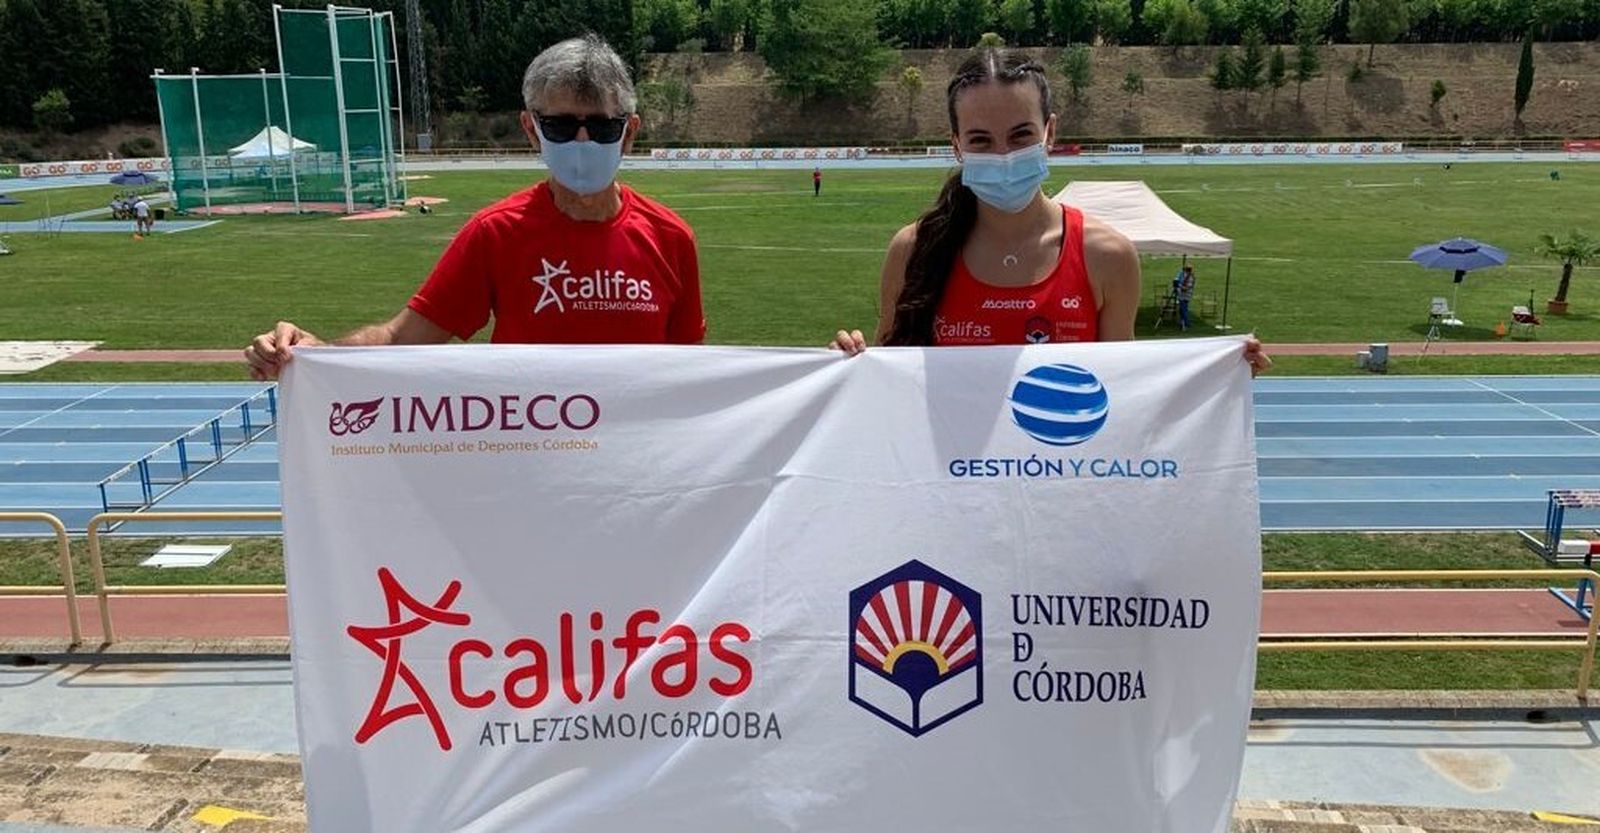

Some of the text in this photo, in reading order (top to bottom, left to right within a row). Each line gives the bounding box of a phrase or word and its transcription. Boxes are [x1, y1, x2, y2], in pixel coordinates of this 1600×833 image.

[563, 269, 653, 300] califas
[1061, 298, 1080, 309] GO
[940, 321, 992, 337] califas
[392, 394, 601, 433] IMDECO
[331, 438, 599, 456] Instituto Municipal de Deportes Córdoba
[949, 454, 1178, 478] GESTIÓN Y CALOR
[1011, 594, 1210, 629] UNIVERSIDAD
[449, 609, 753, 709] califas
[1013, 661, 1147, 703] CÓRDOBA
